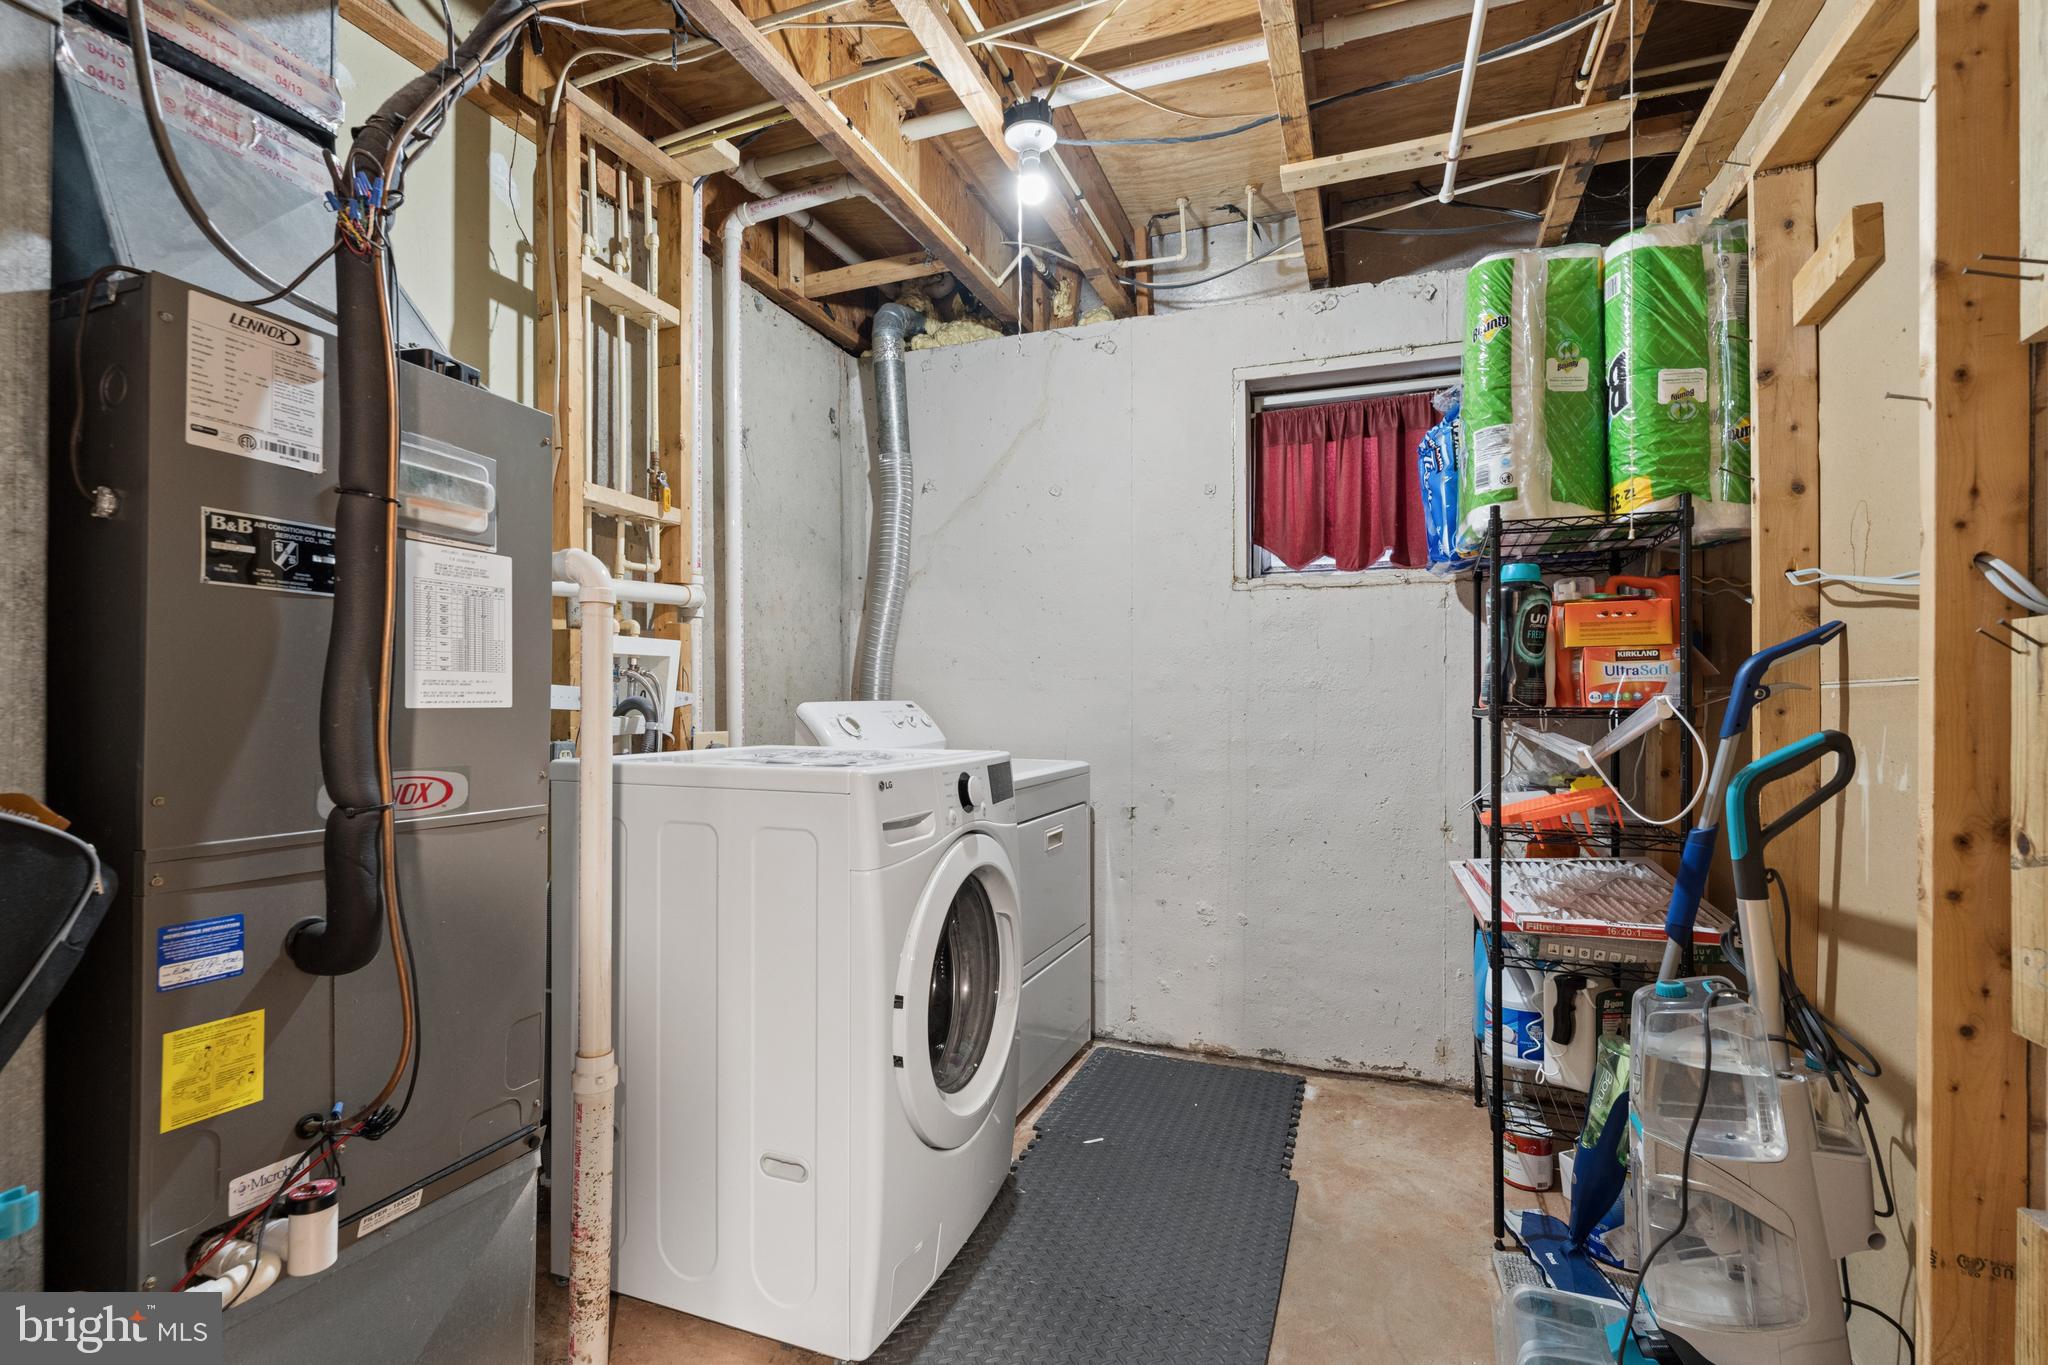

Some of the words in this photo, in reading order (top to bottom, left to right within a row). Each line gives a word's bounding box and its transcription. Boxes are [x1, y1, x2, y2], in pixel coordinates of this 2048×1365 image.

[229, 312, 288, 342] LENNOX
[1557, 360, 1579, 372] Bounty
[1670, 388, 1695, 401] Bounty
[211, 514, 254, 534] B&B
[1617, 650, 1658, 658] KIRKLAND
[1604, 664, 1669, 677] UltraSoft
[1607, 926, 1642, 938] 16x20x1
[1596, 1070, 1614, 1108] Bona
